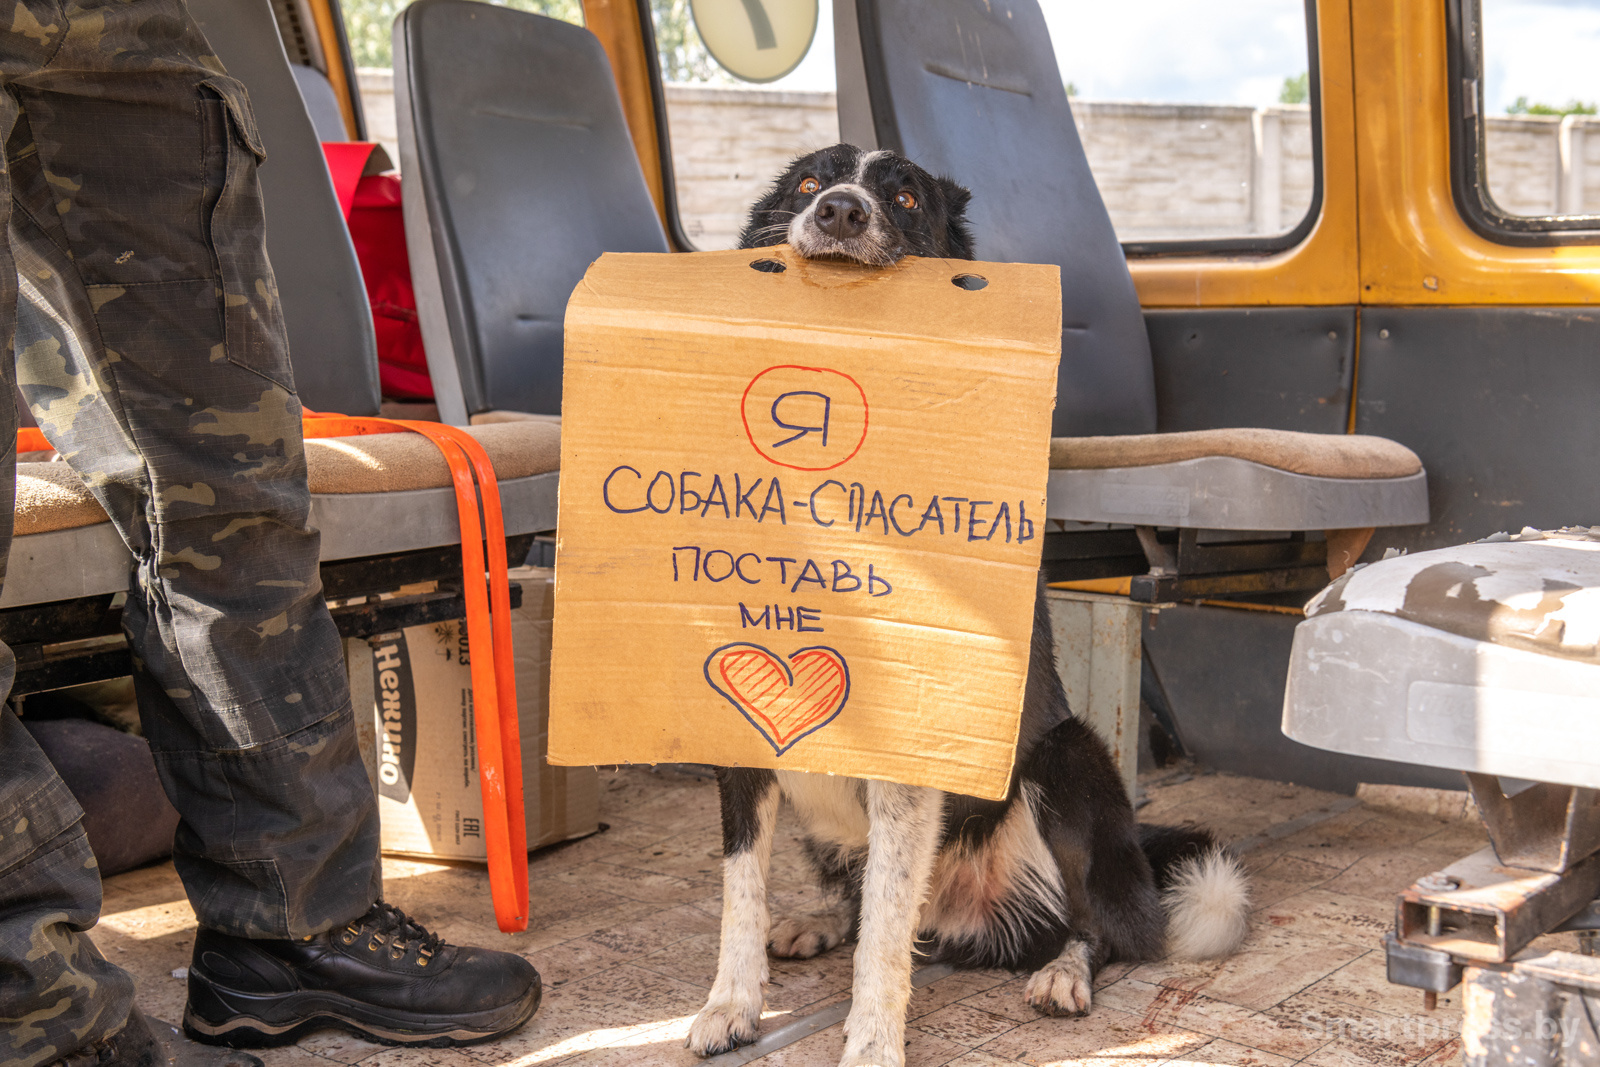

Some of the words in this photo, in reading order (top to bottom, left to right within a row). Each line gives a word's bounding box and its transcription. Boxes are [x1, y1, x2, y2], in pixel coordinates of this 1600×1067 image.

[770, 390, 831, 447] Я
[602, 465, 1035, 544] СОБАКА-СПАСАТЕЛЬ
[672, 546, 893, 597] ПОСТАВЬ
[738, 602, 825, 633] МНЕ
[374, 643, 402, 786] Нежино
